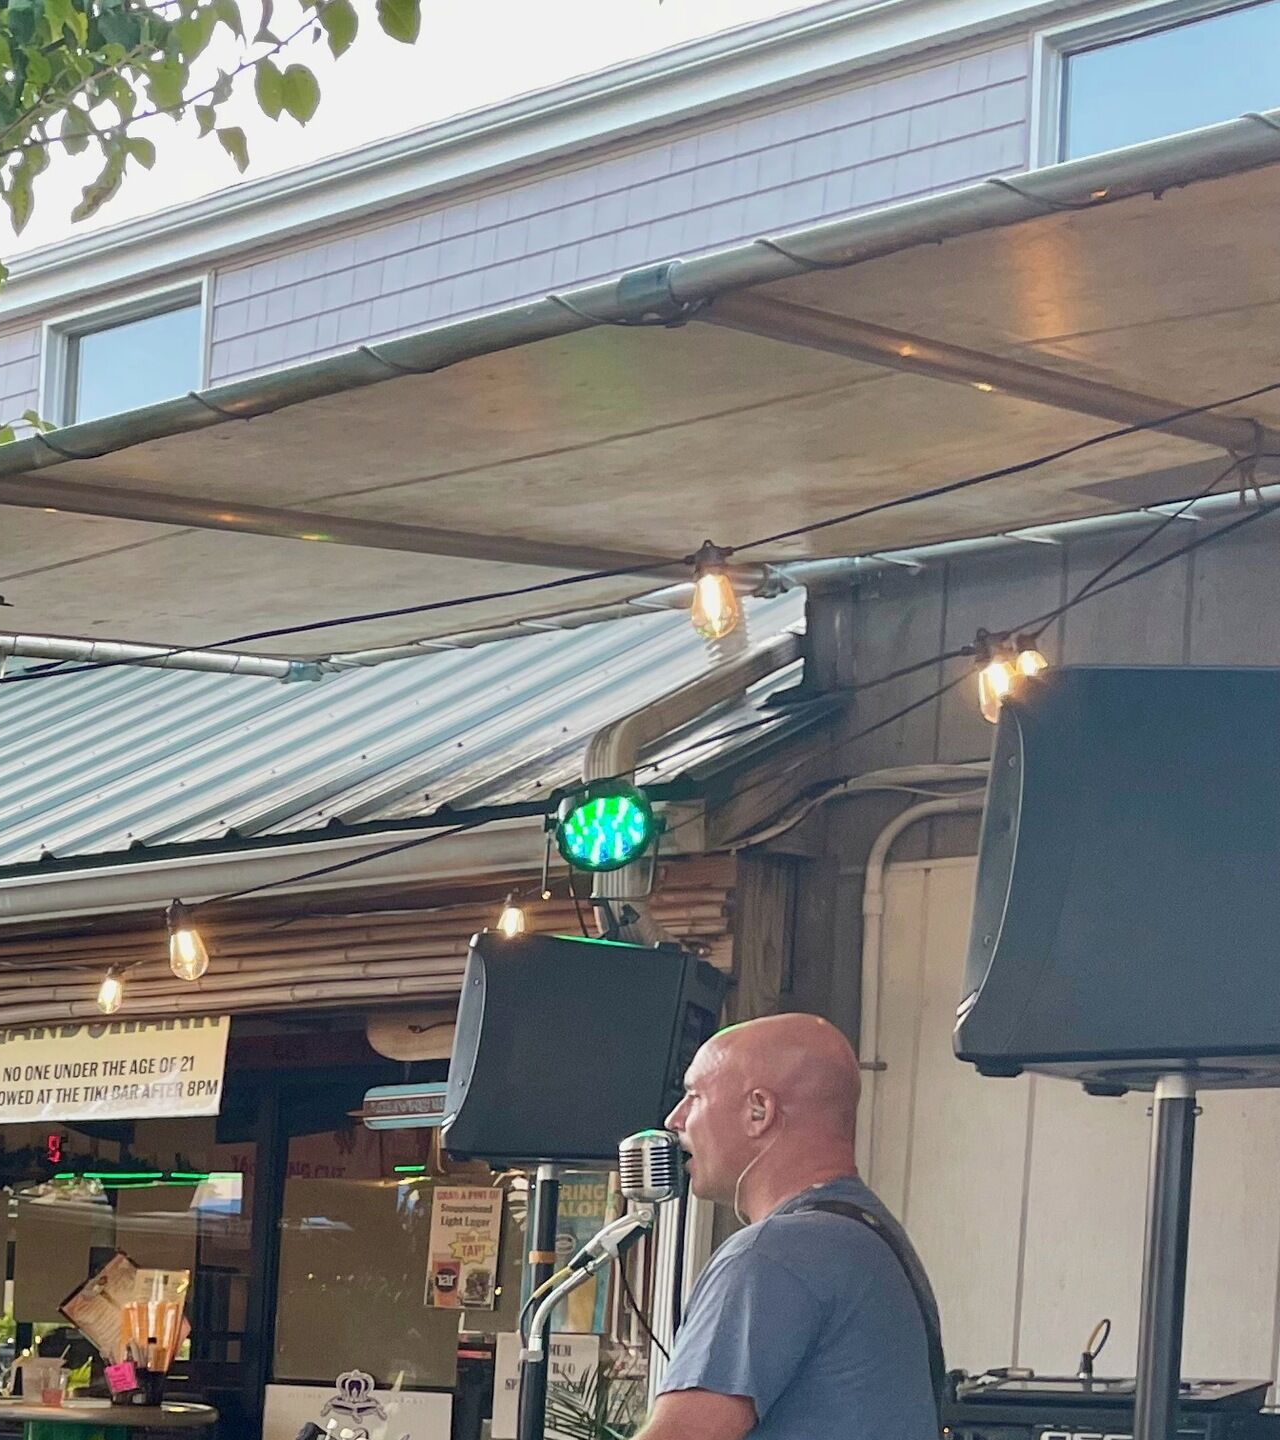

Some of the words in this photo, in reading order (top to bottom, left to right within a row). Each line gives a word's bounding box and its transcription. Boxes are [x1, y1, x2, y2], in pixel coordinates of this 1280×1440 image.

[2, 1066, 21, 1082] NO
[24, 1064, 51, 1081] ONE
[54, 1061, 98, 1079] UNDER
[102, 1060, 127, 1076] THE
[129, 1058, 156, 1075] AGE
[159, 1056, 177, 1073] OF
[180, 1055, 195, 1072] 21
[36, 1088, 53, 1104] AT
[55, 1086, 79, 1103] THE
[83, 1085, 108, 1102] TIKI
[112, 1083, 139, 1100] BAR
[141, 1081, 184, 1099] AFTER
[187, 1079, 219, 1097] 8PM
[441, 1215, 463, 1227] Light
[465, 1216, 490, 1228] Lager
